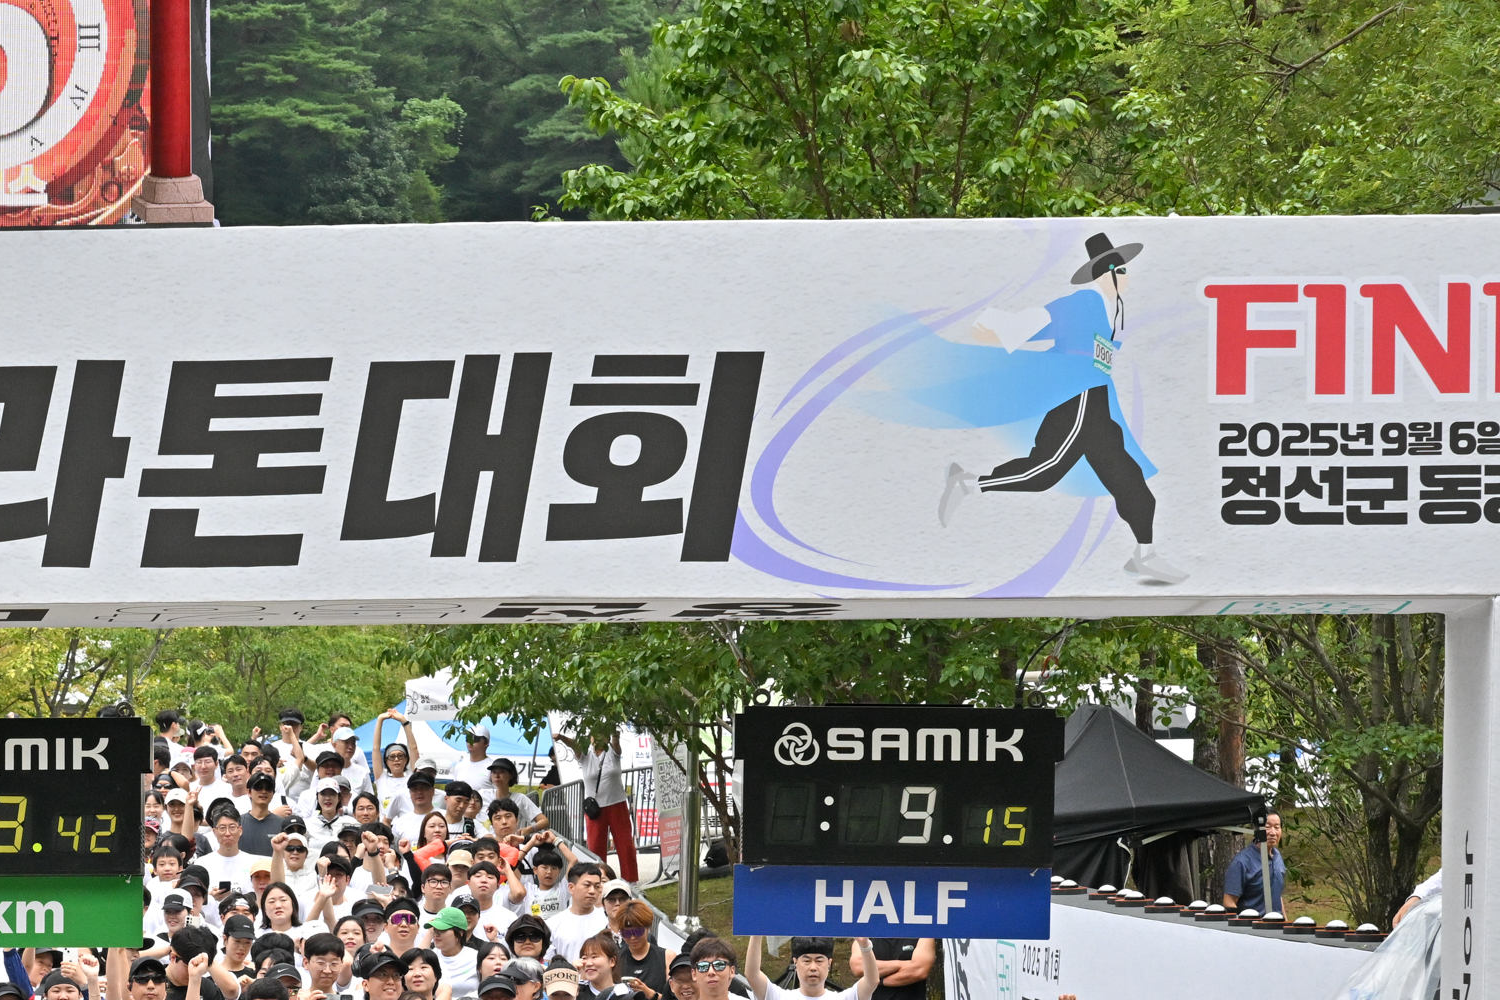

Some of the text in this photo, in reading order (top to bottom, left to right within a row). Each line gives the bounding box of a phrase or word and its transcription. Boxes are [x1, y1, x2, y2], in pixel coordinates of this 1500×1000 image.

[1218, 421, 1374, 457] 2025년
[1379, 421, 1443, 456] 9월
[1220, 465, 1409, 526] 정선군
[826, 727, 1024, 762] SAMIK
[813, 879, 969, 925] HALF
[544, 971, 579, 984] SPORT
[1022, 943, 1041, 977] 2025
